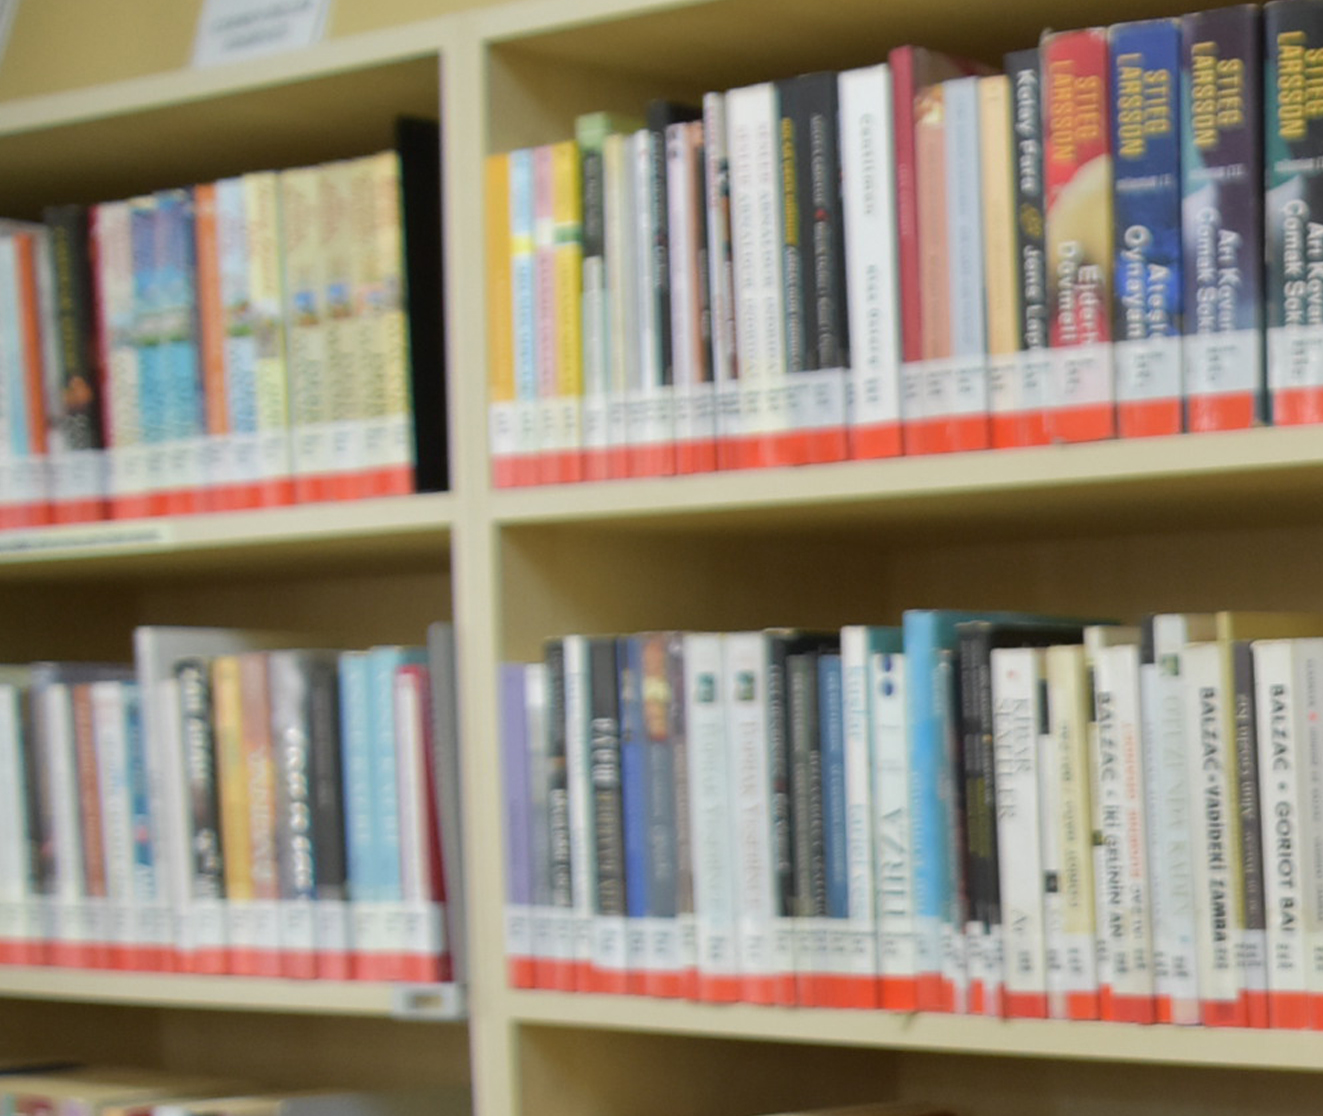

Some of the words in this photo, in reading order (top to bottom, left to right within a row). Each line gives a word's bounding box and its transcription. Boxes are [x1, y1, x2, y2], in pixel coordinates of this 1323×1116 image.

[1051, 59, 1075, 161] LARSSON
[1077, 75, 1099, 139] STIEG
[1117, 53, 1144, 158] LARSSON
[1144, 69, 1171, 134] STIEG
[1191, 41, 1218, 149] LARSSON
[1217, 58, 1244, 127] STIEG
[1277, 31, 1307, 140] LARSSON
[1199, 687, 1219, 771] BALZAC
[1270, 684, 1291, 772] BALZAC
[1274, 800, 1297, 889] GORIOT
